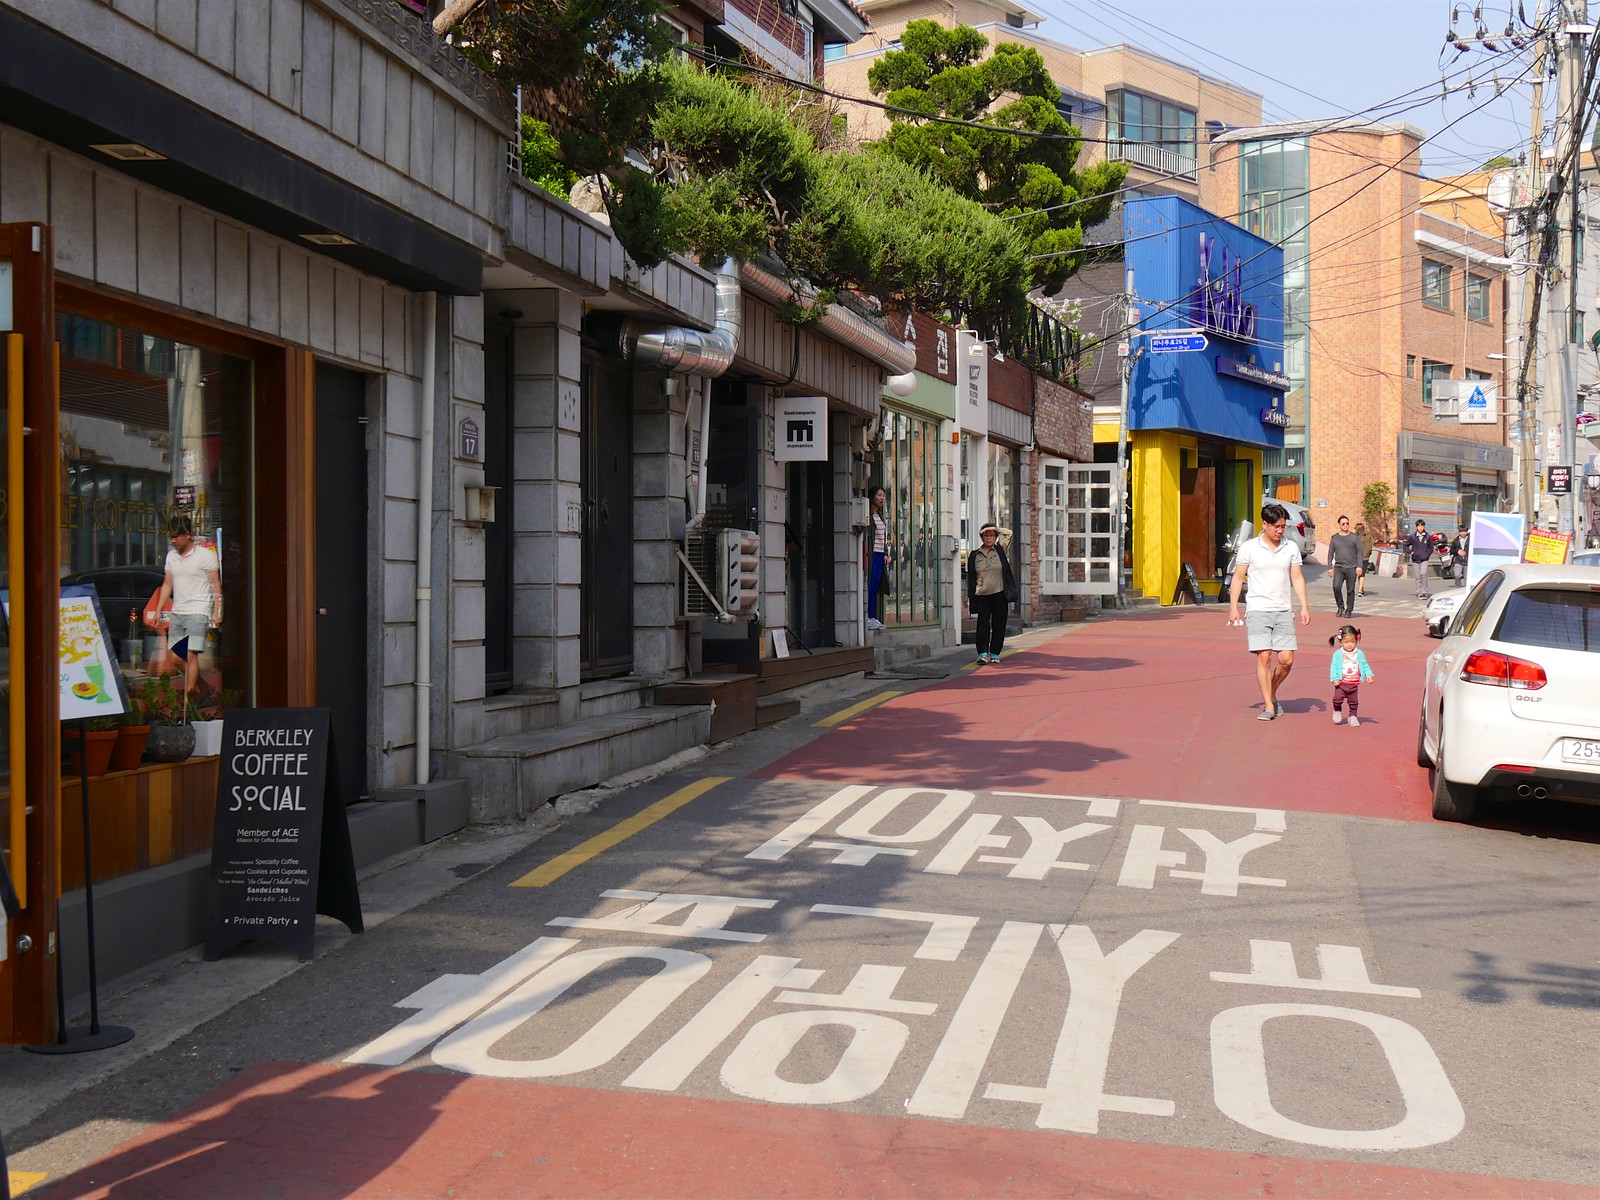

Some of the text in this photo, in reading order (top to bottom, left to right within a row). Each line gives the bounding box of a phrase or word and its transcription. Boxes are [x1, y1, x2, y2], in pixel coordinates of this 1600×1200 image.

[465, 438, 475, 454] 17
[93, 497, 155, 534] COFFEE
[60, 604, 88, 613] OLDEN
[235, 729, 313, 746] BERKELEY
[231, 753, 308, 776] COFFEE
[229, 785, 306, 811] SOCIAL
[237, 828, 299, 837] Member of ACE
[255, 858, 280, 866] Specialty
[280, 868, 307, 876] Cupcakes
[233, 916, 291, 926] Private Party
